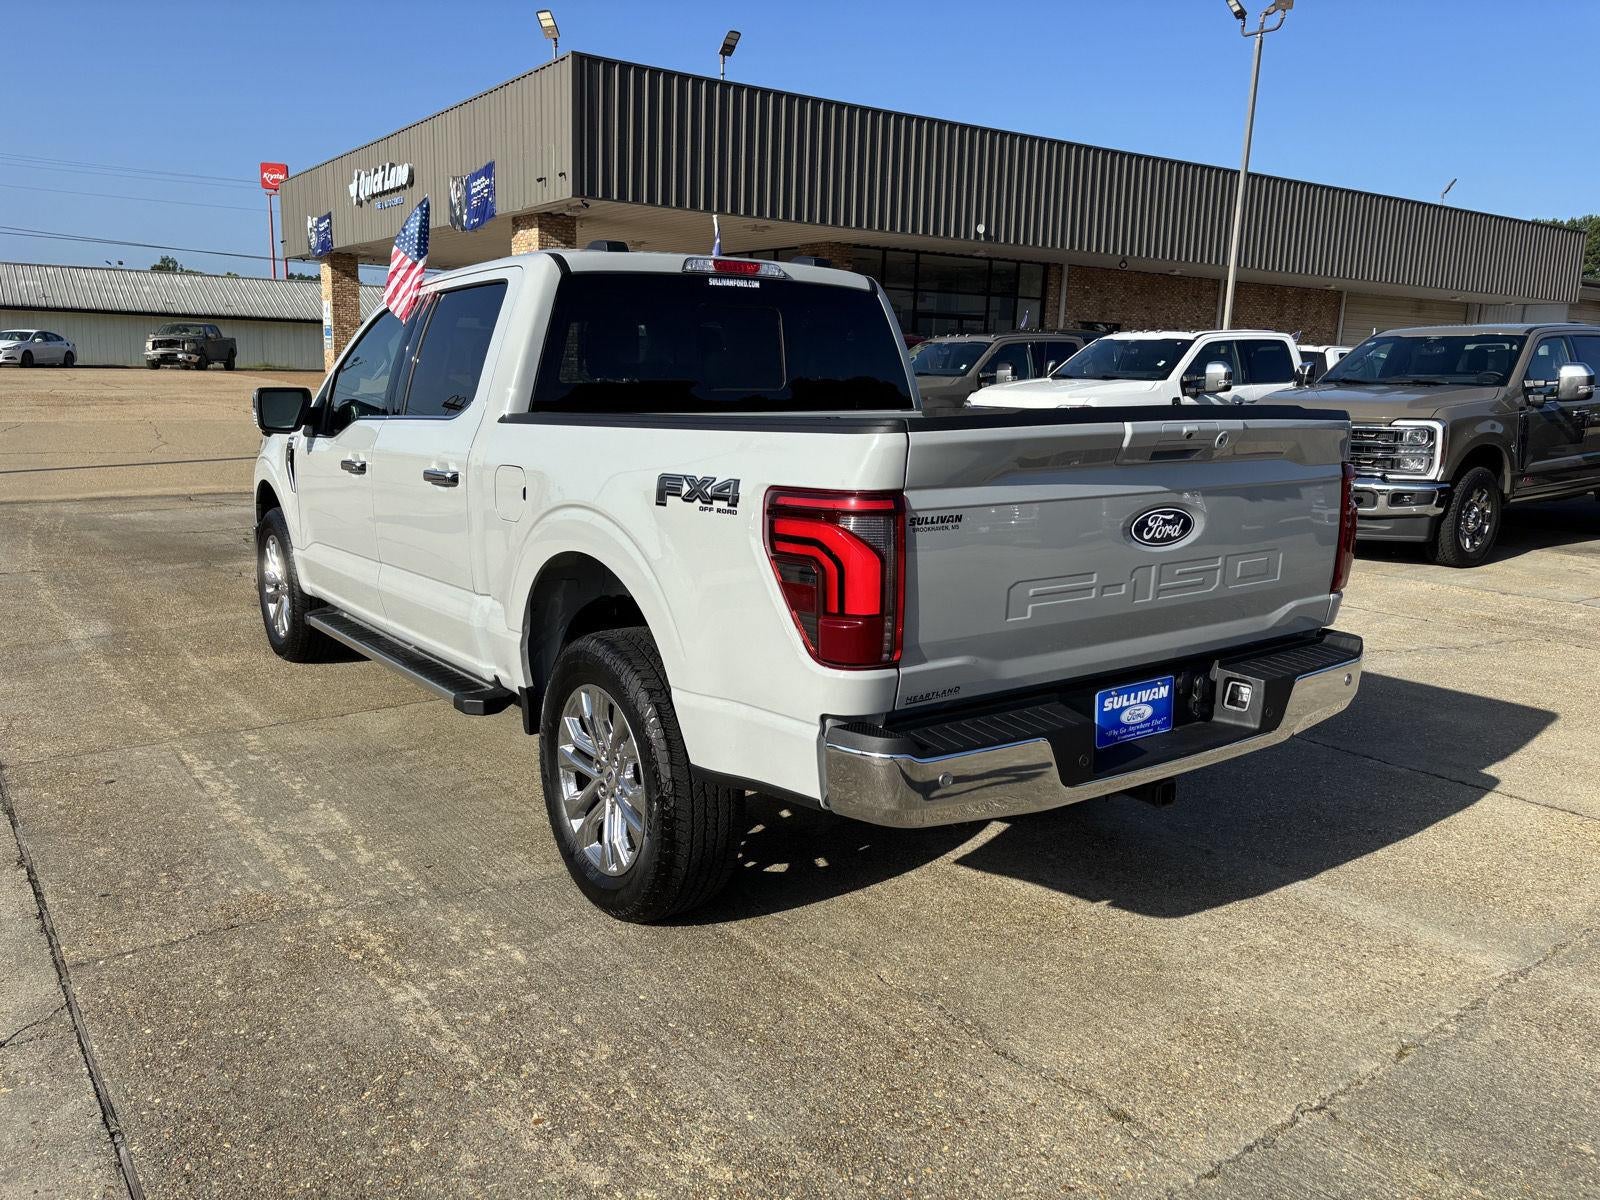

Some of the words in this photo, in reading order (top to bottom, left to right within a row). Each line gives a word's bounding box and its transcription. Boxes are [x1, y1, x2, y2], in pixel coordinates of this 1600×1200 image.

[263, 172, 285, 181] Krystal
[359, 165, 384, 201] Quick
[383, 162, 409, 191] Lane
[708, 278, 760, 288] SULLIVANFORD.COM
[655, 473, 741, 507] FX4
[698, 505, 714, 513] OFF
[716, 507, 738, 516] ROAD
[909, 514, 963, 527] SULLIVAN
[1143, 513, 1184, 540] Ford
[1005, 548, 1283, 622] F-150
[905, 686, 961, 704] HEARTLAND
[1103, 685, 1170, 712] SULLIVAN
[1126, 708, 1147, 722] Ford
